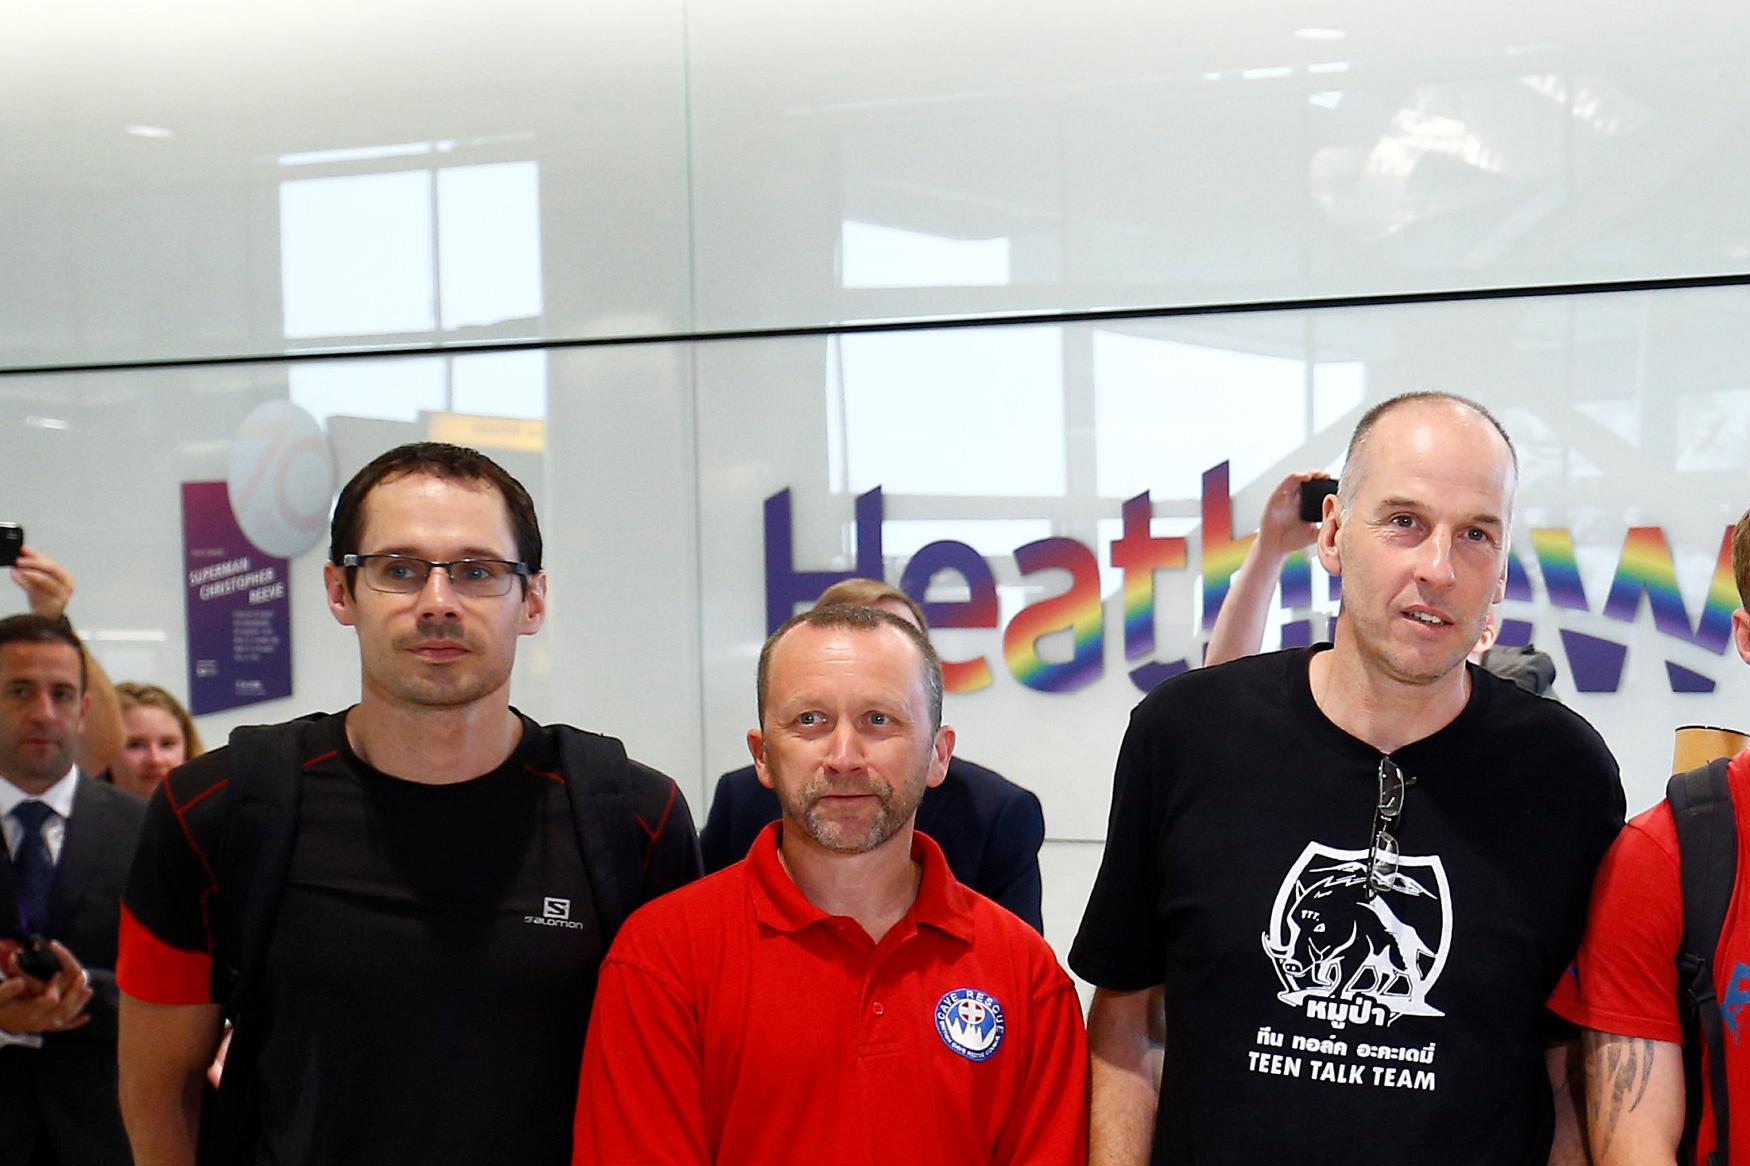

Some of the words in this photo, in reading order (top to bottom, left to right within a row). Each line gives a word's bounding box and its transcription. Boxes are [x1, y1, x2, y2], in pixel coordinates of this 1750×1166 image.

[189, 556, 249, 587] SUPERMAN
[199, 567, 275, 601] CHRISTOPHER
[248, 582, 285, 605] REEVE
[937, 993, 959, 1020] CAVE
[1249, 1051, 1301, 1077] TEEN
[1310, 1060, 1366, 1085] TALK
[1373, 1066, 1436, 1091] TEAM
